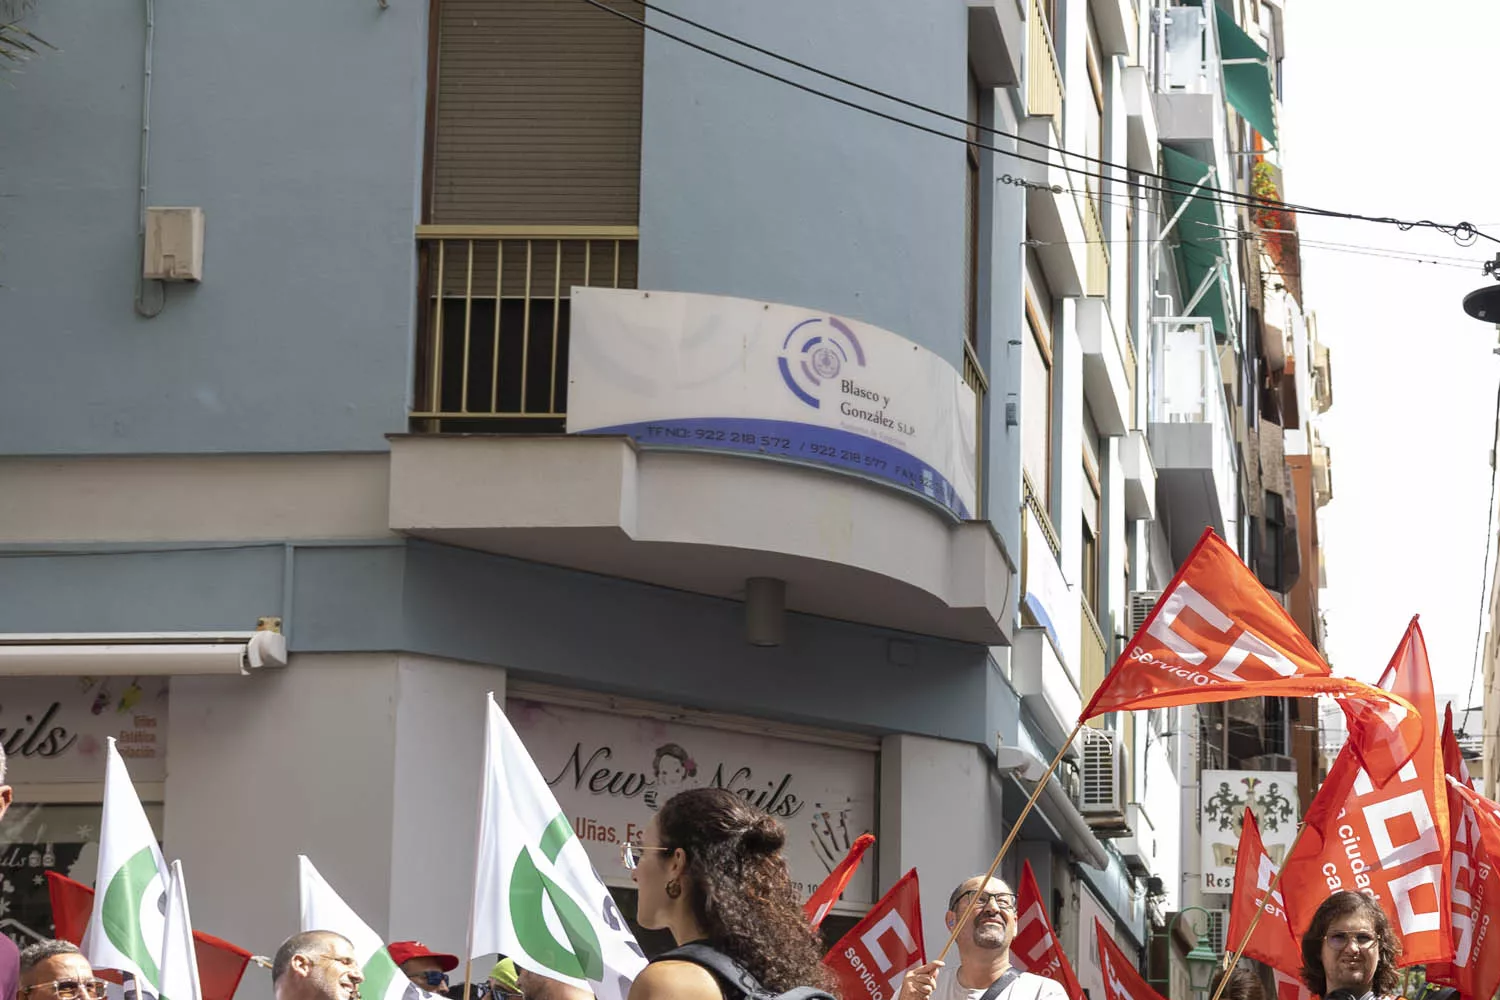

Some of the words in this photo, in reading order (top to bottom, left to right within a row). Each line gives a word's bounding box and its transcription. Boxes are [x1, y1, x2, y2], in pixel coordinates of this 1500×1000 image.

[841, 379, 880, 403] Blasco
[882, 396, 891, 410] y
[840, 401, 895, 430] González
[695, 429, 726, 442] 922
[730, 432, 756, 445] 218
[760, 435, 791, 450] 572
[810, 443, 836, 458] 922
[840, 449, 861, 465] 218
[863, 455, 887, 472] 577
[544, 743, 655, 799] New
[576, 817, 621, 846] Uñas,
